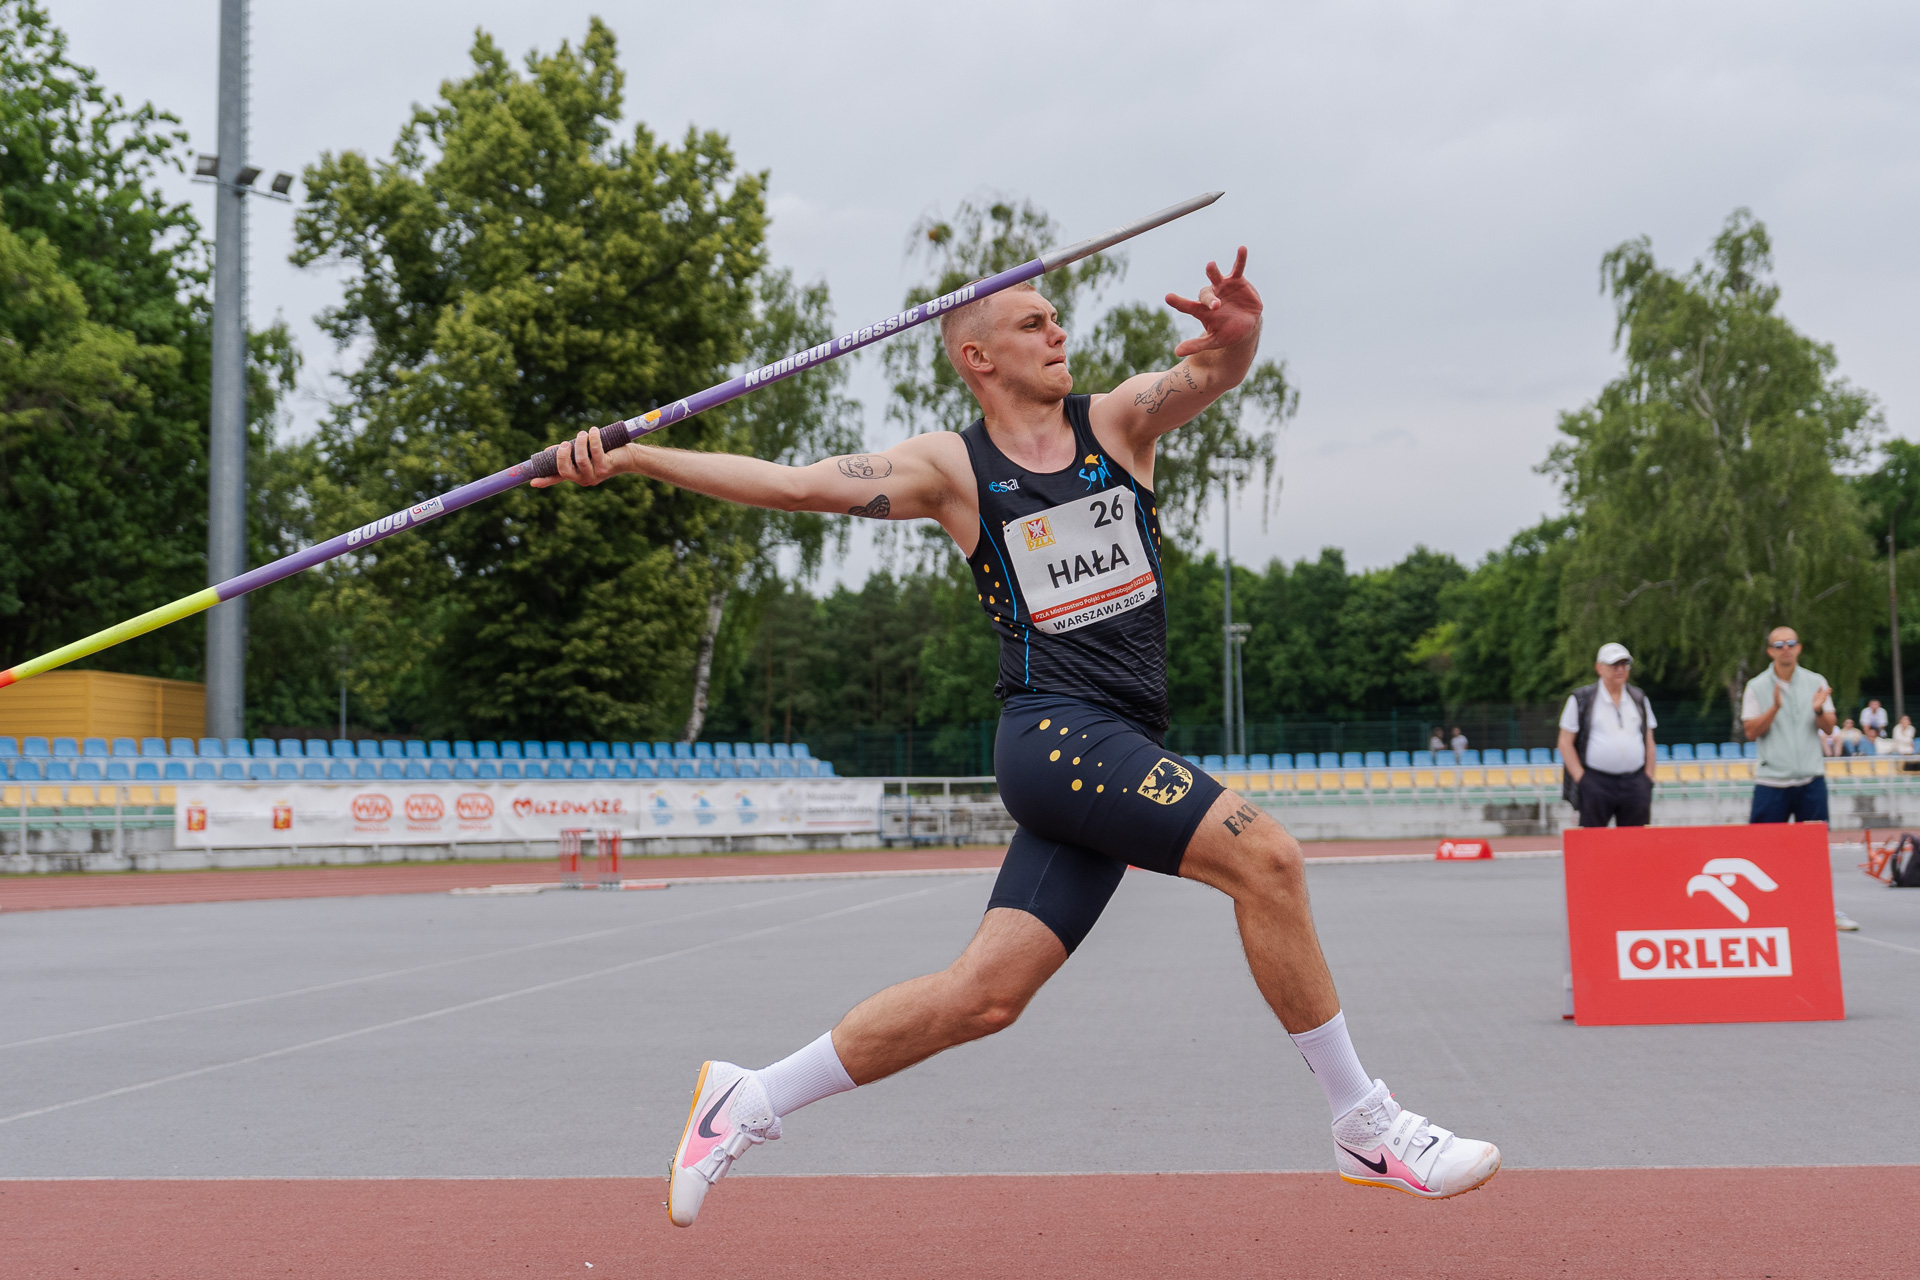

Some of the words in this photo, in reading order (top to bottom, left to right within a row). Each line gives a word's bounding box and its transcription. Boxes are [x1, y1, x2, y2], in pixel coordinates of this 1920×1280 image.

[745, 342, 831, 388] Nemeth
[838, 307, 919, 350] classic
[926, 285, 976, 315] 85m
[346, 510, 409, 546] 800g
[1089, 494, 1124, 529] 26
[1028, 537, 1055, 549] PZLA
[1047, 543, 1130, 589] HAŁA
[1035, 611, 1050, 620] PZLA
[1050, 601, 1084, 615] Mistrzostwa
[1053, 602, 1122, 630] WARSZAWA
[1123, 591, 1146, 608] 2025
[1628, 936, 1778, 970] ORLEN
